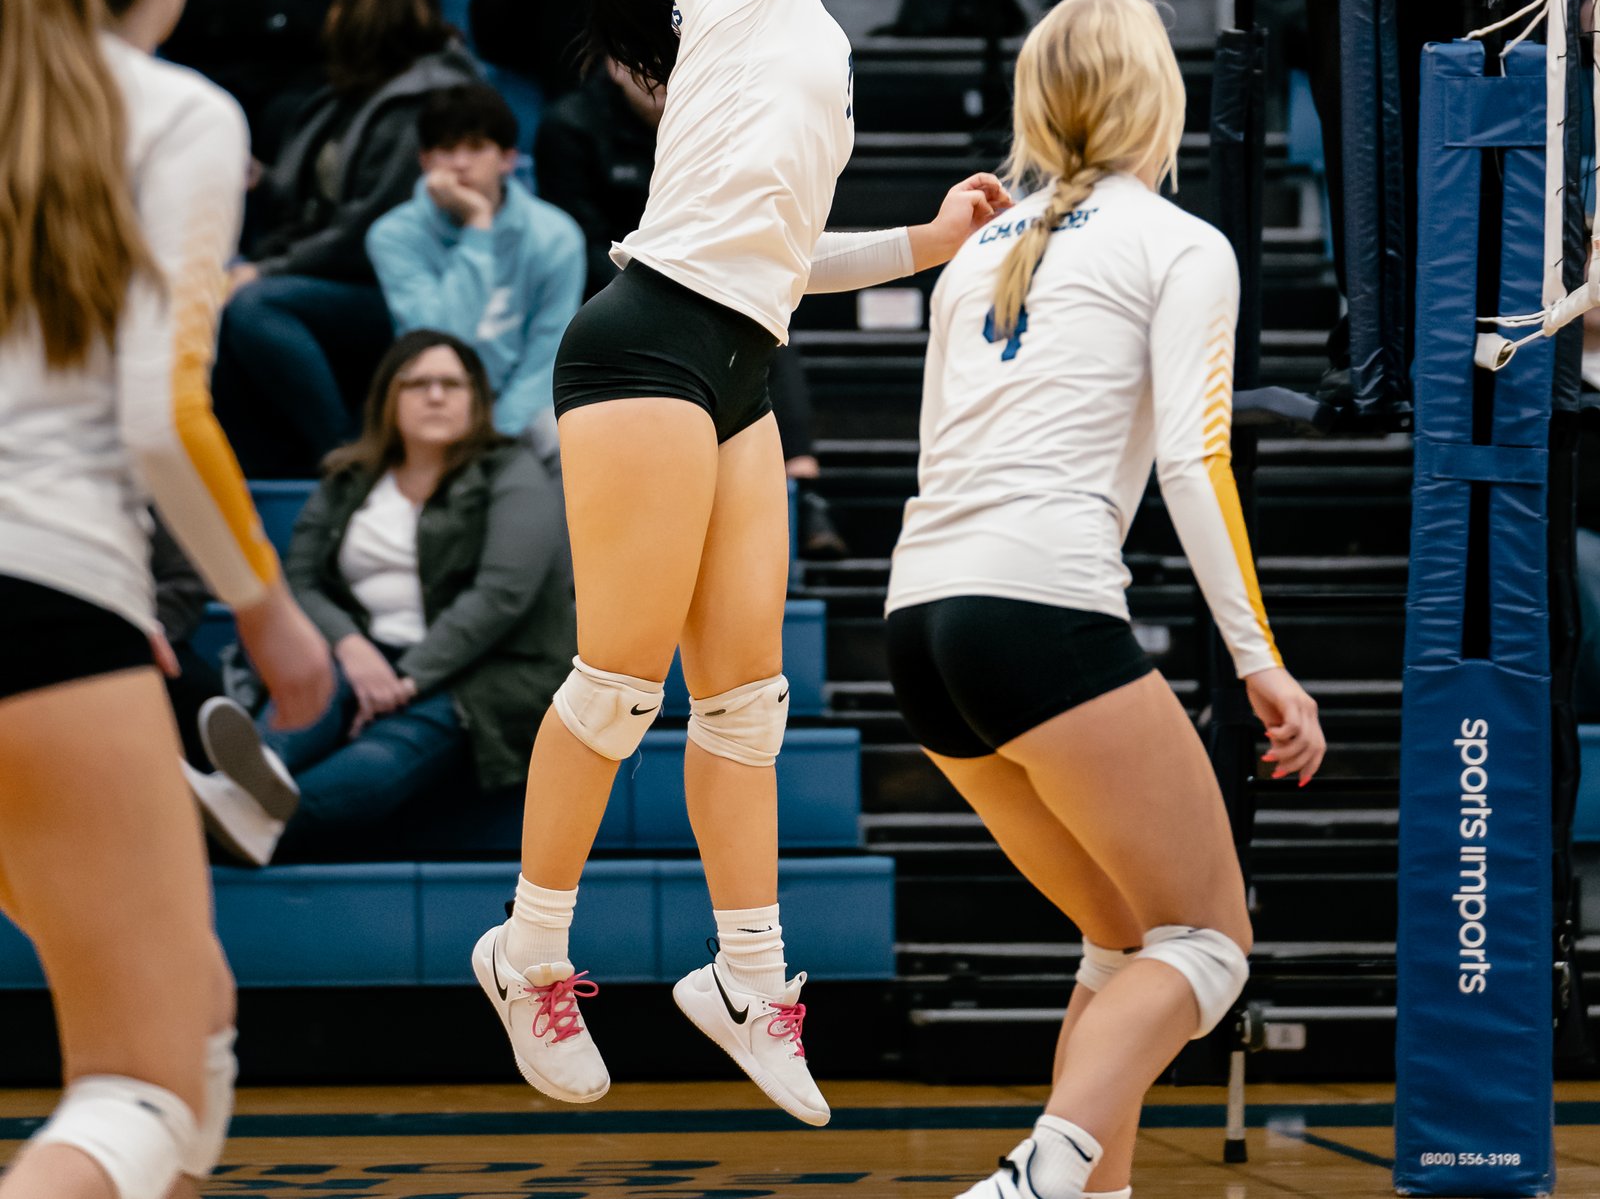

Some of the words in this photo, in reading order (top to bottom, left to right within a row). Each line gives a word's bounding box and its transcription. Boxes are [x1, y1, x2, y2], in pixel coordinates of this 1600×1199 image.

[1453, 718, 1493, 839] sports
[1451, 846, 1492, 994] imports
[1420, 1152, 1456, 1167] (800)
[1457, 1152, 1521, 1166] 556-3198
